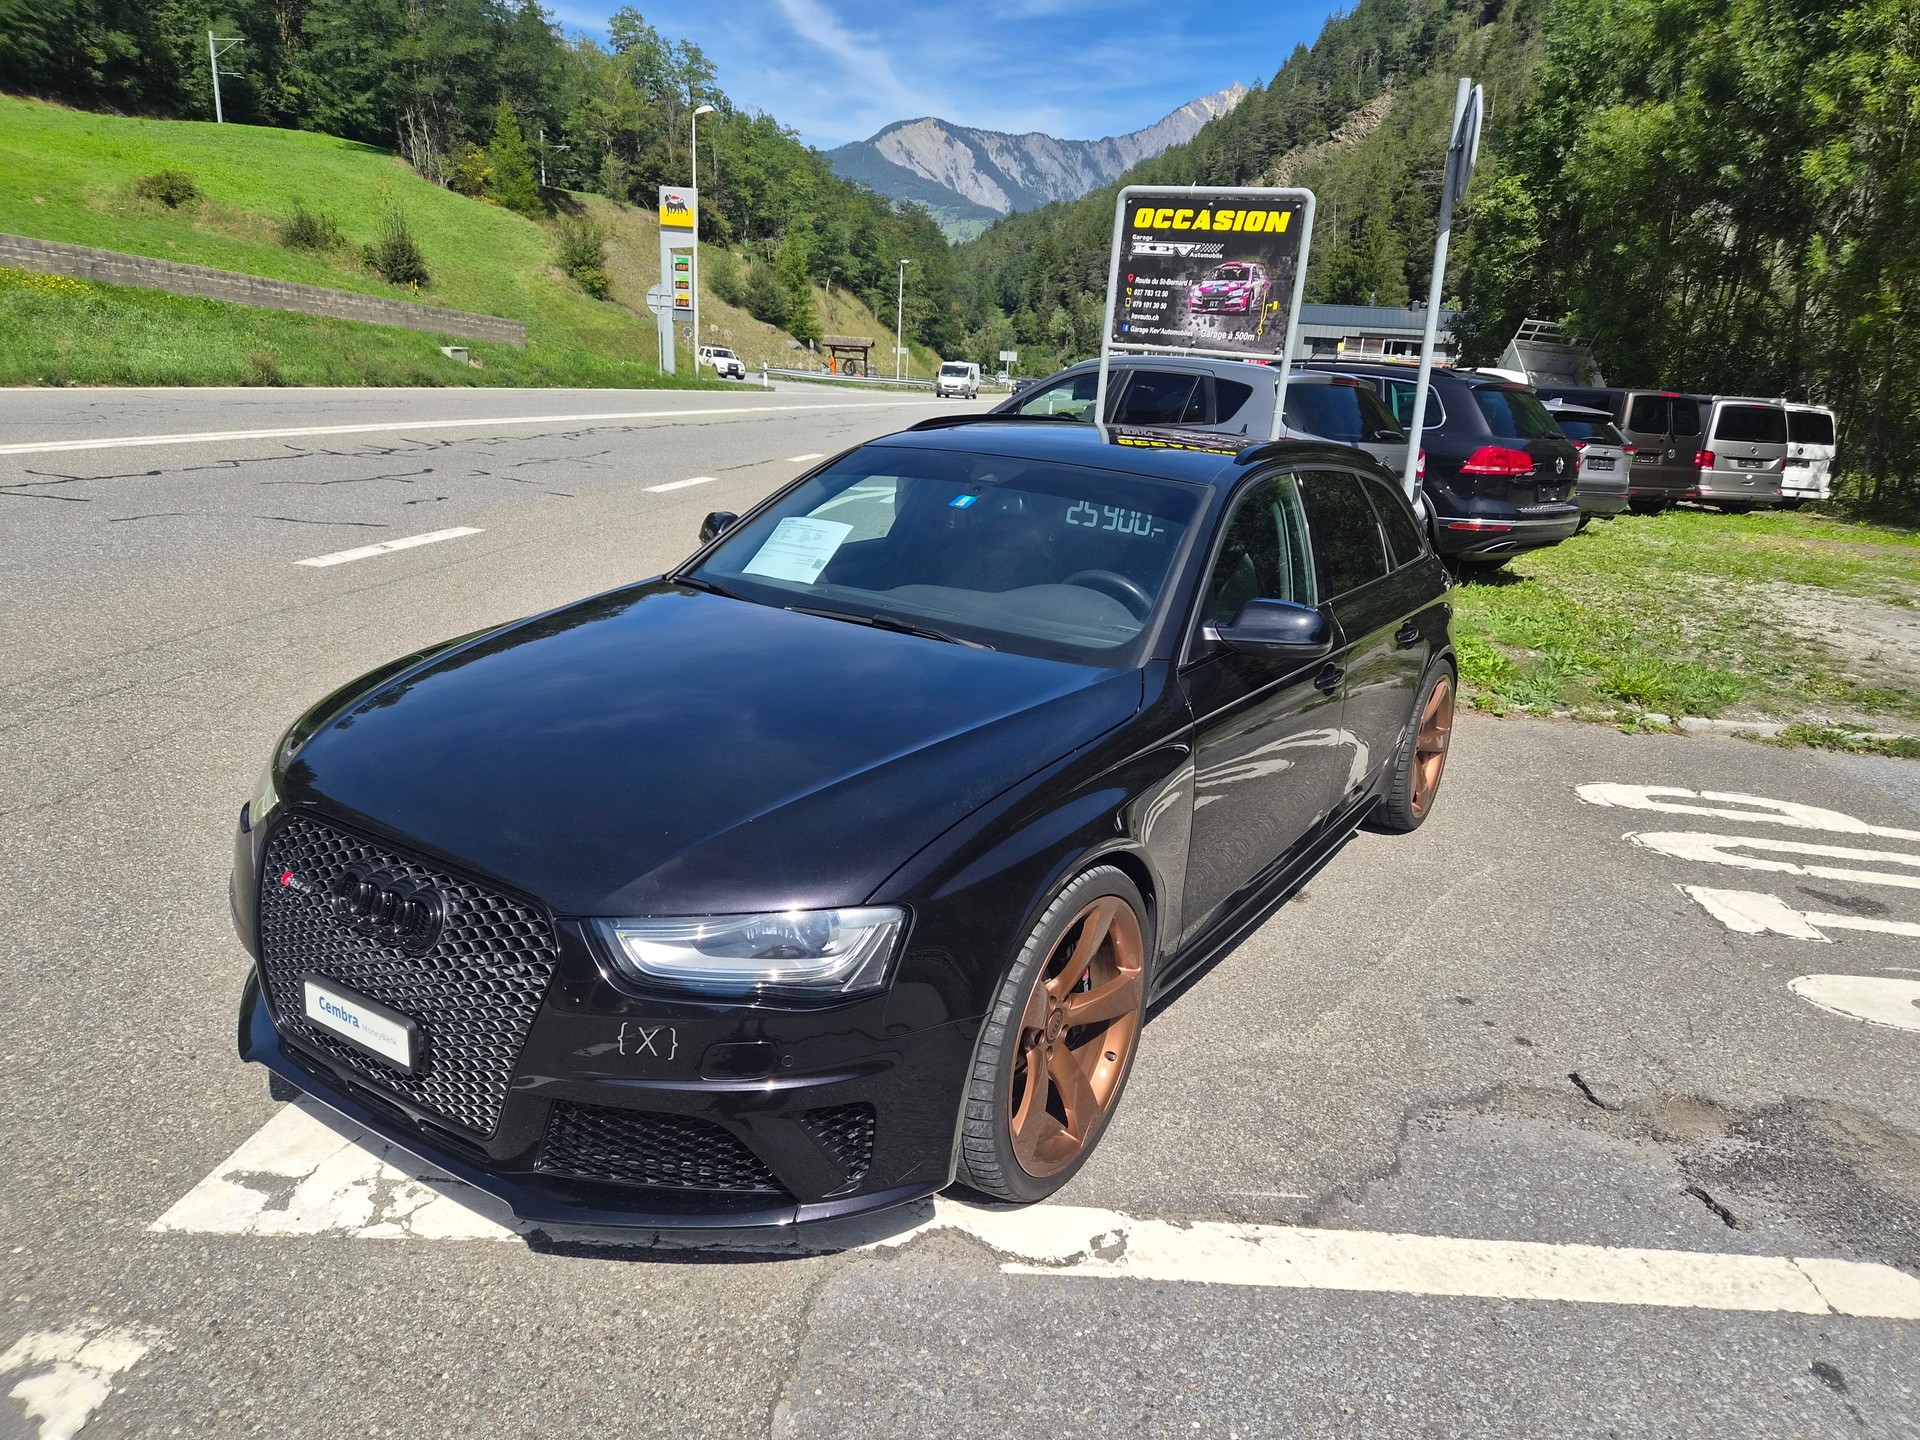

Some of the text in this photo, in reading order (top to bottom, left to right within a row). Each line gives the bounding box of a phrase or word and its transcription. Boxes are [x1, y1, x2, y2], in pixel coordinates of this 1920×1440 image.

[1133, 207, 1292, 233] OCCASION
[1132, 234, 1153, 242] Garage
[1134, 276, 1151, 285] Route
[1159, 278, 1188, 287] St-Bernard
[1133, 288, 1144, 296] 027
[1132, 300, 1143, 308] 079
[1160, 302, 1168, 310] 50
[1130, 312, 1160, 321] kevauto.ch
[1130, 325, 1149, 335] Garage
[1200, 329, 1256, 342] Garage à 500m
[318, 996, 398, 1047] Cembra MoneyBank
